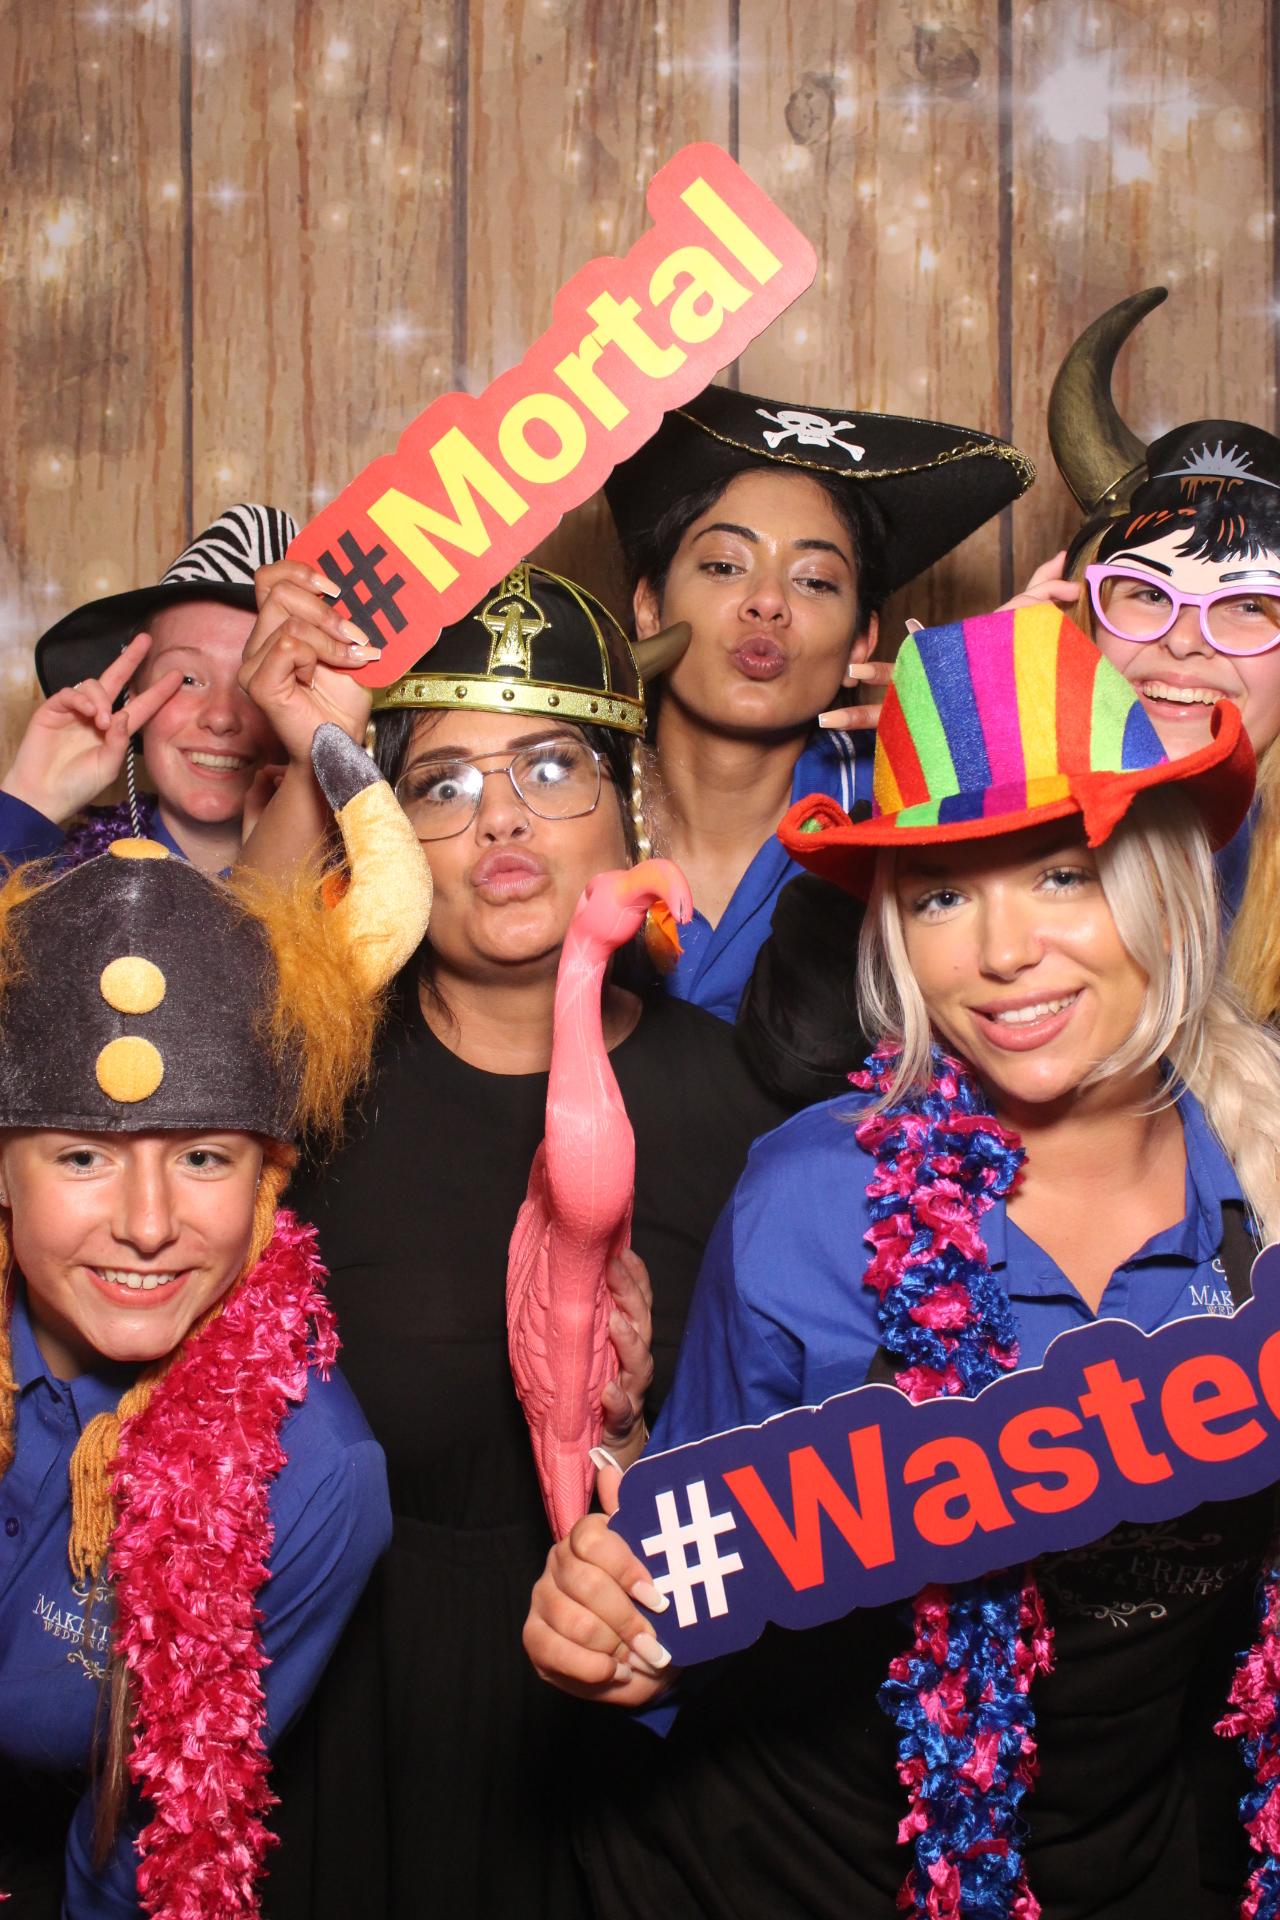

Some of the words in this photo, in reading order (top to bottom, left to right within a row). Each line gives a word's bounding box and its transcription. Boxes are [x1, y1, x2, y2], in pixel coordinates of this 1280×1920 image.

[317, 176, 783, 650] #Mortal
[1189, 1285, 1234, 1306] MAK
[641, 1331, 1280, 1628] #Waste
